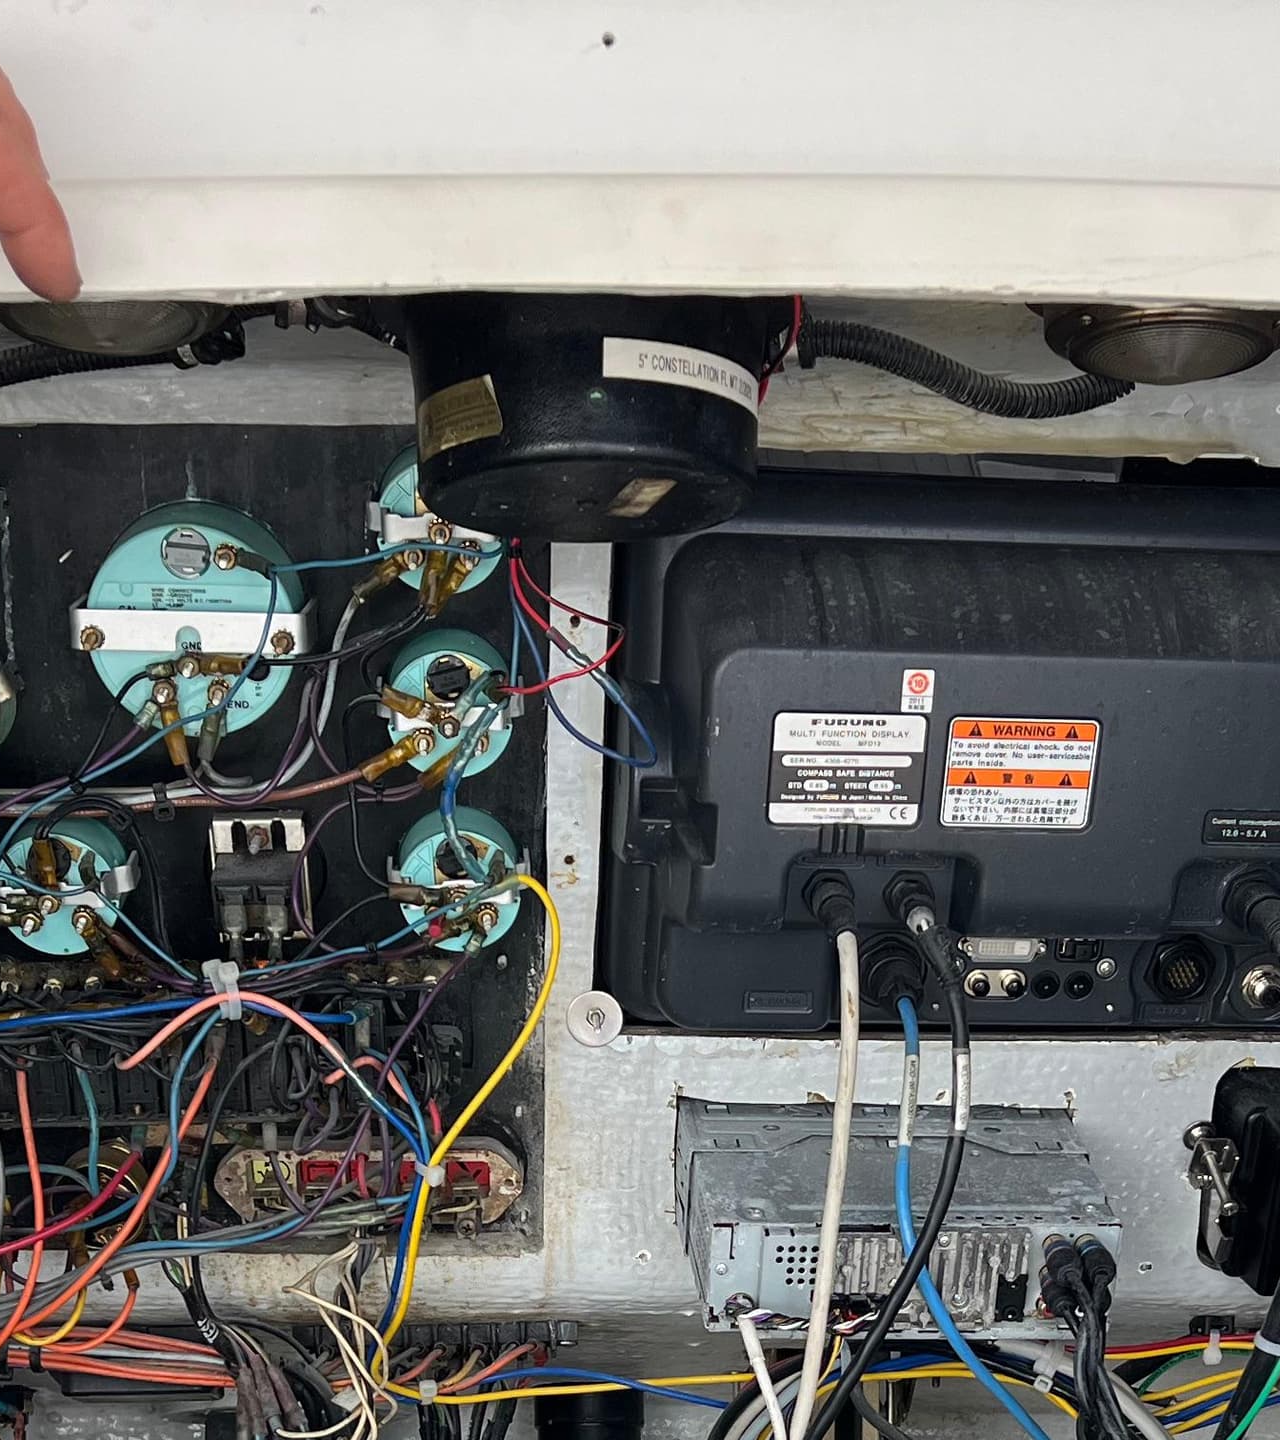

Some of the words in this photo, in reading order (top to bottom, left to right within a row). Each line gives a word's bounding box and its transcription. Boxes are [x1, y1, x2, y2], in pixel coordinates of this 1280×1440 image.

[651, 355, 719, 384] CONSTELLATION
[181, 641, 202, 650] GND
[224, 700, 251, 710] END
[811, 718, 888, 727] FURUNO
[789, 730, 816, 738] MULTI
[821, 730, 867, 738] FUNCTION
[871, 730, 910, 739] DISPLAY
[993, 725, 1056, 738] WARNING
[953, 741, 963, 749] To
[1011, 751, 1023, 759] No
[1027, 752, 1090, 760] user-serviceable
[951, 759, 973, 768] parts
[797, 769, 833, 778] COMPASS
[835, 769, 856, 777] SAFE
[858, 770, 895, 778] DISTANCE
[1212, 817, 1237, 826] Current
[1238, 818, 1280, 828] consumption
